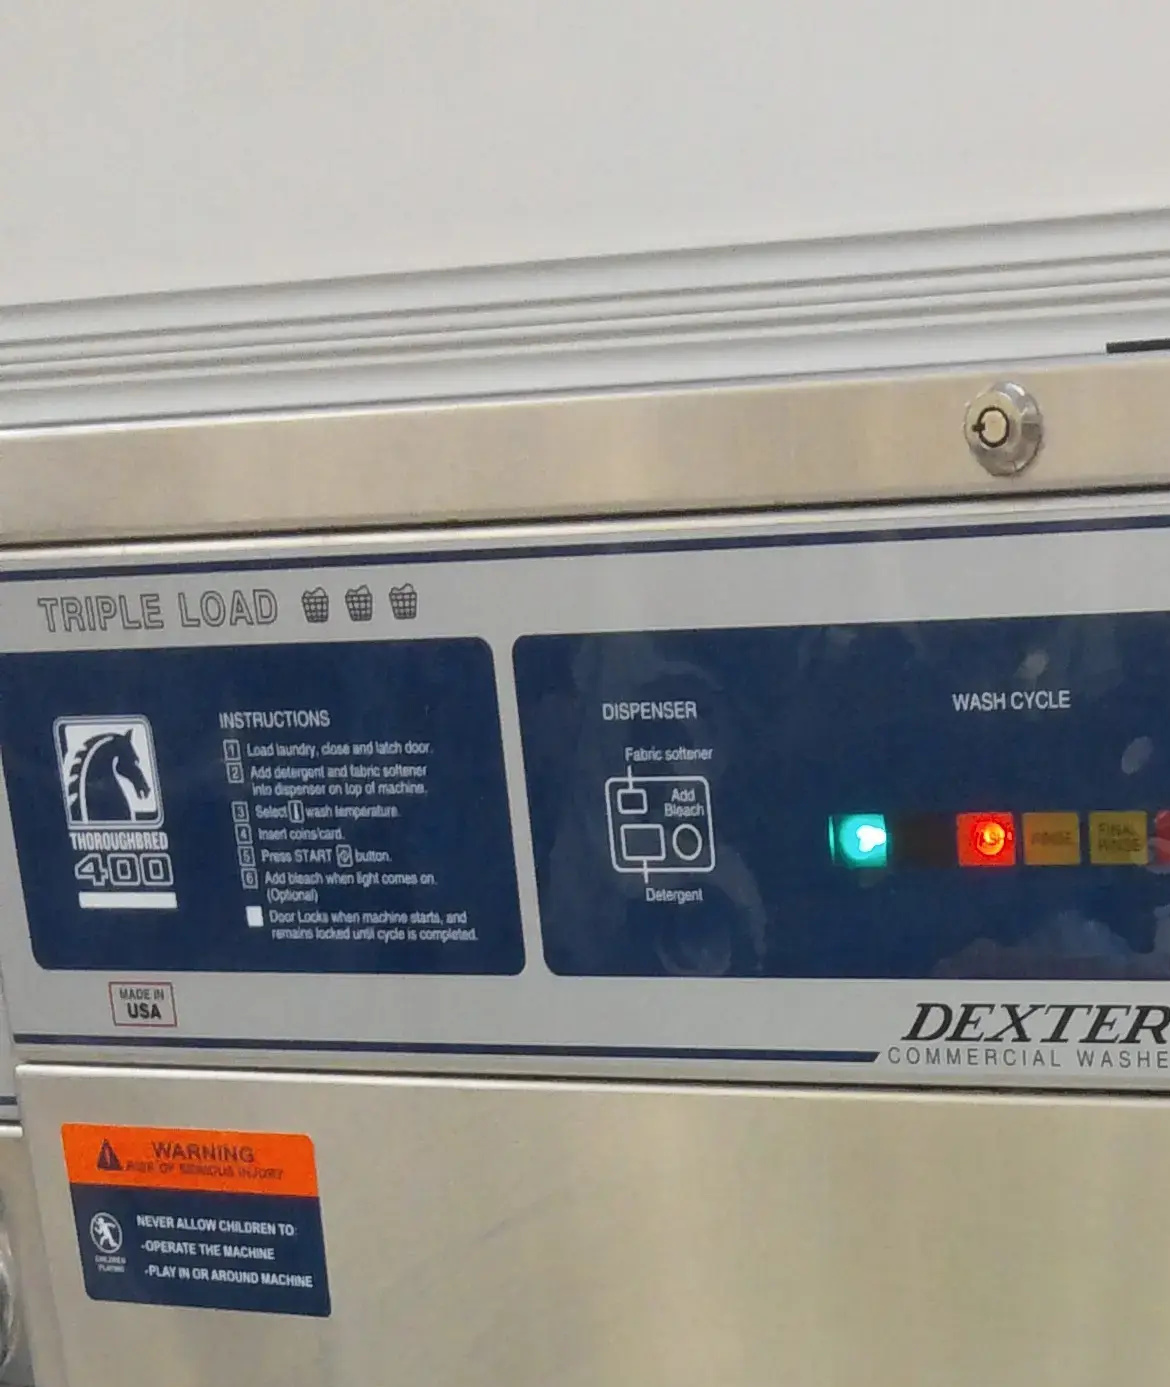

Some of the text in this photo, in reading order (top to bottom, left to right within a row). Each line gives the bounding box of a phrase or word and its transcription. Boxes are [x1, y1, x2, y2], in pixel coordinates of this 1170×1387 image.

[37, 588, 278, 633] TRIPLE LOAD
[952, 690, 1071, 711] WASH CYCLE
[219, 709, 331, 729] INSTRUCTIONS
[602, 701, 698, 721] DISPENSER
[247, 743, 274, 757] Load
[276, 743, 319, 759] laundry,
[321, 742, 350, 756] close
[353, 741, 373, 755] and
[375, 741, 402, 755] latch
[404, 740, 434, 754] door.
[625, 745, 714, 762] Fabric softener
[251, 766, 272, 779] Add
[274, 766, 325, 782] detergent
[328, 765, 348, 778] and
[350, 764, 380, 777] fabric
[383, 764, 427, 777] softener
[252, 781, 428, 798] into dispenser on top of machine.
[671, 788, 695, 802] Add
[255, 804, 288, 819] Select
[305, 805, 333, 818] wash
[664, 803, 705, 817] Bleach
[69, 831, 169, 851] THOROUGHBRED
[258, 828, 287, 840] Insert
[261, 849, 292, 862] Press
[294, 848, 332, 862] START
[354, 848, 392, 862] button.
[74, 853, 174, 886] 400
[265, 871, 286, 884] Add
[288, 871, 323, 885] bleach
[325, 872, 354, 884] when
[356, 871, 379, 887] light
[381, 873, 418, 885] comes
[267, 887, 319, 904] (Optional)
[646, 887, 703, 904] Detergent
[269, 909, 295, 923] Door
[298, 910, 329, 924] Locks
[331, 911, 360, 923] when
[362, 910, 408, 924] machine
[446, 910, 467, 923] and
[272, 926, 314, 939] remains
[316, 926, 350, 940] locked
[353, 927, 374, 940] until
[377, 927, 405, 944] cycle
[407, 928, 417, 940] is
[119, 988, 164, 1001] MADE IN
[127, 1003, 162, 1020] USA
[888, 1046, 1061, 1068] COMMERCIAL
[152, 1140, 255, 1163] WARNING
[136, 1215, 174, 1229] NEVER
[177, 1217, 217, 1231] ALLOW
[219, 1219, 276, 1235] CHILDREN
[199, 1243, 221, 1257] THE
[222, 1245, 275, 1260] MACHINE
[178, 1266, 190, 1280] IN
[192, 1267, 210, 1281] OR
[211, 1269, 259, 1285] AROUND
[261, 1272, 314, 1288] MACHINE
